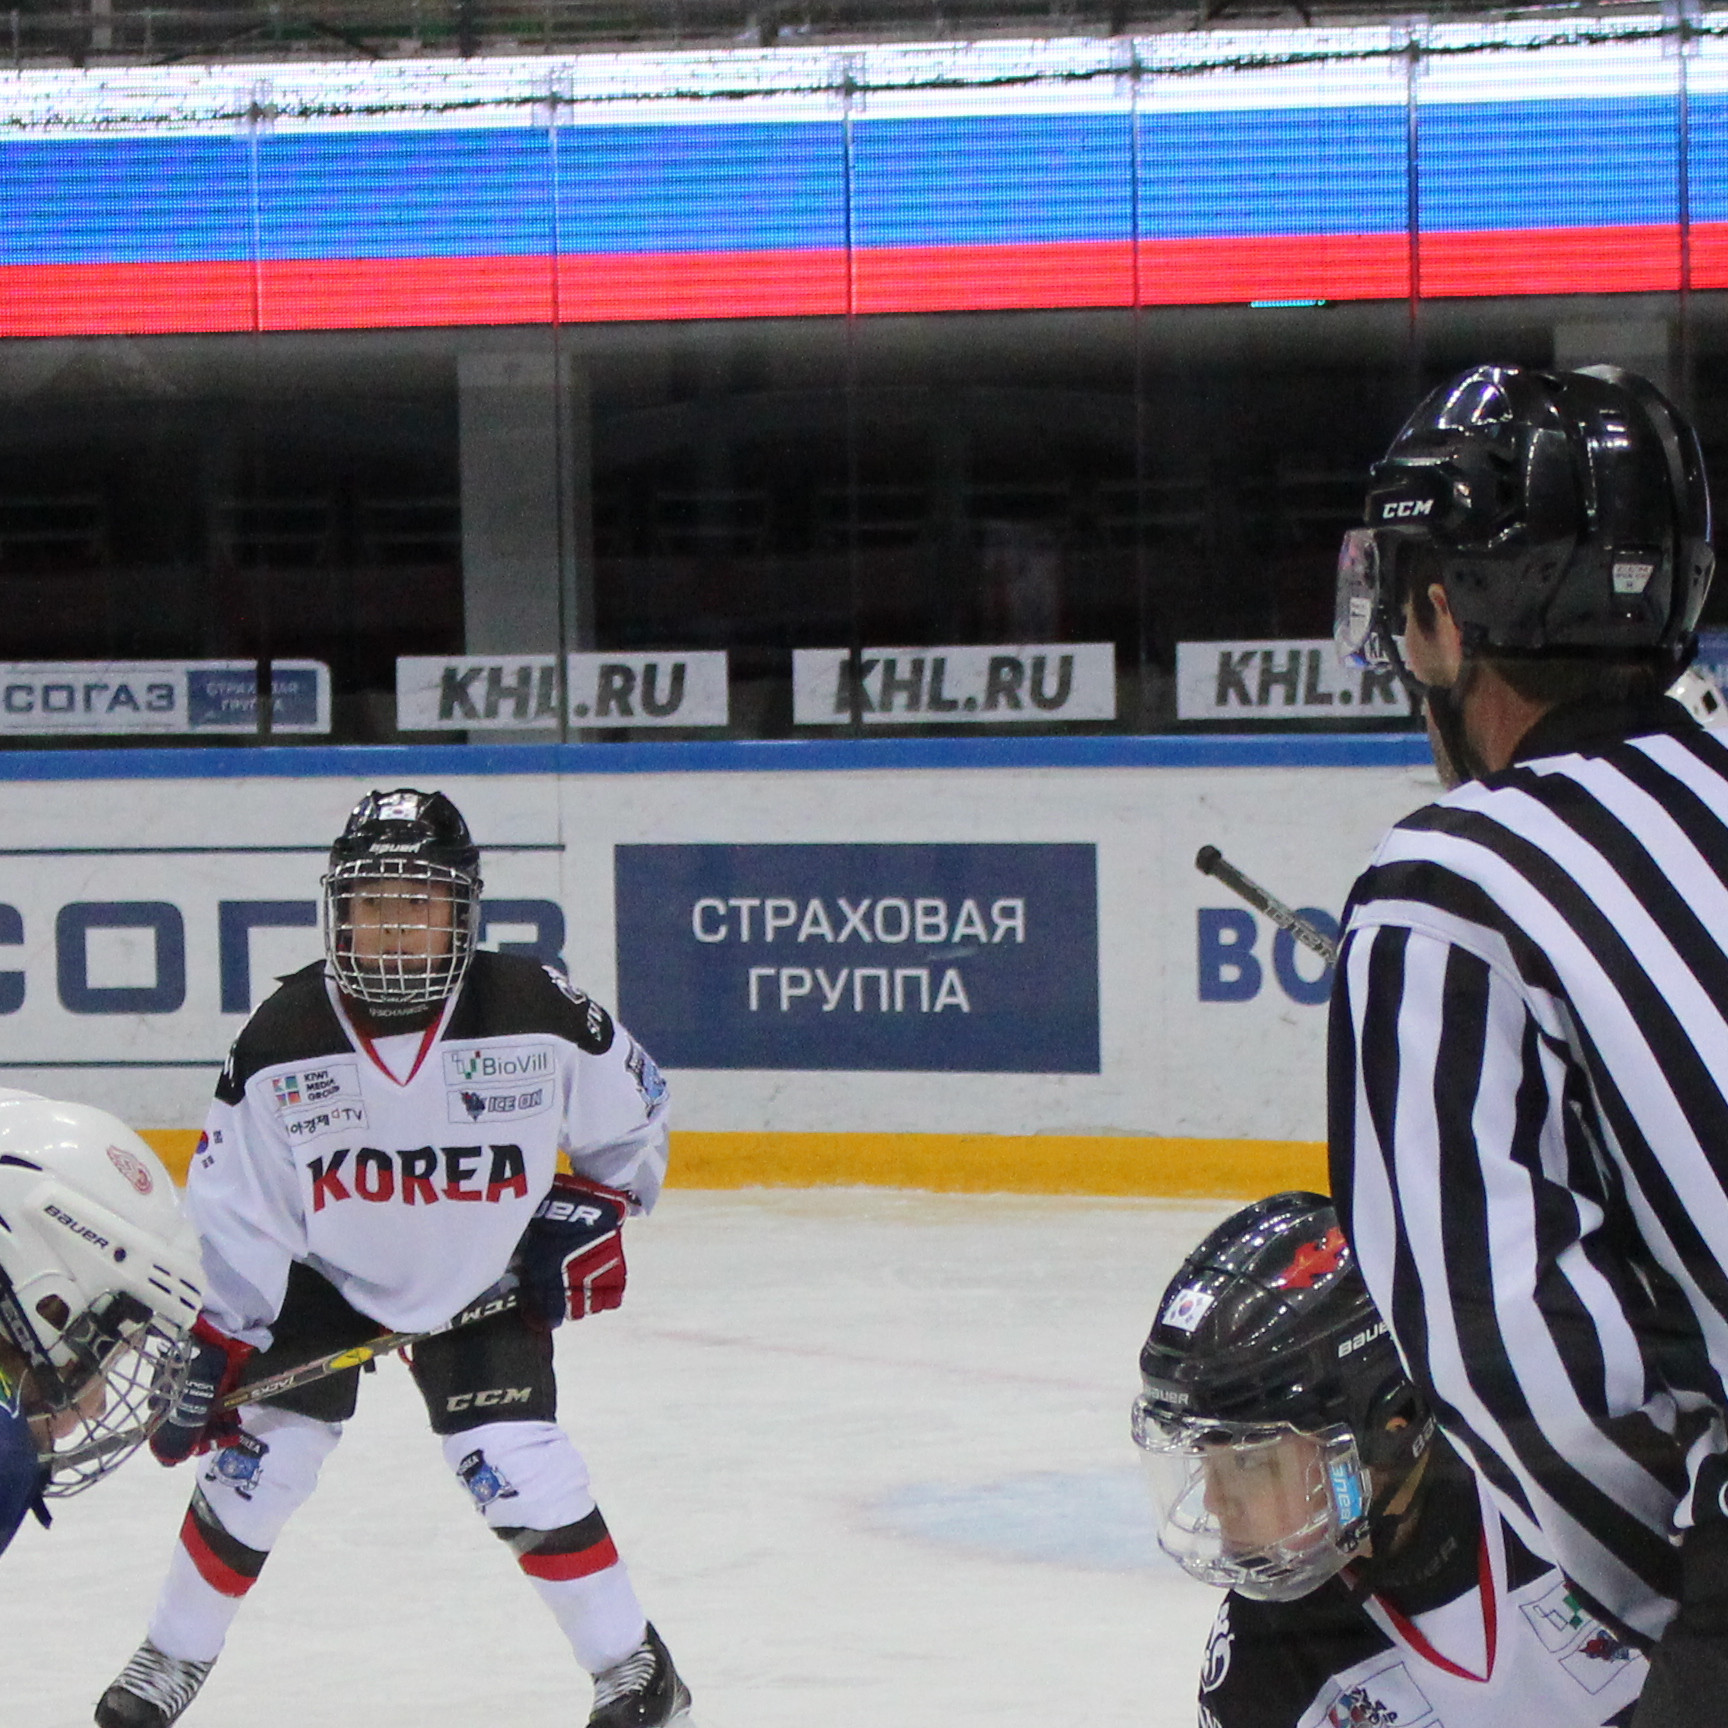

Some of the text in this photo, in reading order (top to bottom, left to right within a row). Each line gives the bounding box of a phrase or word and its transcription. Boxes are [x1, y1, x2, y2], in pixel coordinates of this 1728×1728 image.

[1382, 499, 1435, 520] CCM
[438, 662, 686, 720] KHL.RU
[834, 653, 1076, 712] KHL.RU
[3, 683, 176, 713] СОГАЗ
[692, 896, 1026, 945] СТРАХОВАЯ
[748, 967, 972, 1014] ГРУППА
[303, 1069, 329, 1083] KIWI
[482, 1053, 548, 1077] BioVill
[306, 1077, 336, 1093] MEDIA
[307, 1084, 341, 1102] GROUP
[487, 1088, 543, 1113] ICE ON
[341, 1107, 363, 1123] TV
[307, 1143, 529, 1214] KOREA
[43, 1203, 109, 1249] BAUER
[446, 1386, 533, 1413] CCM
